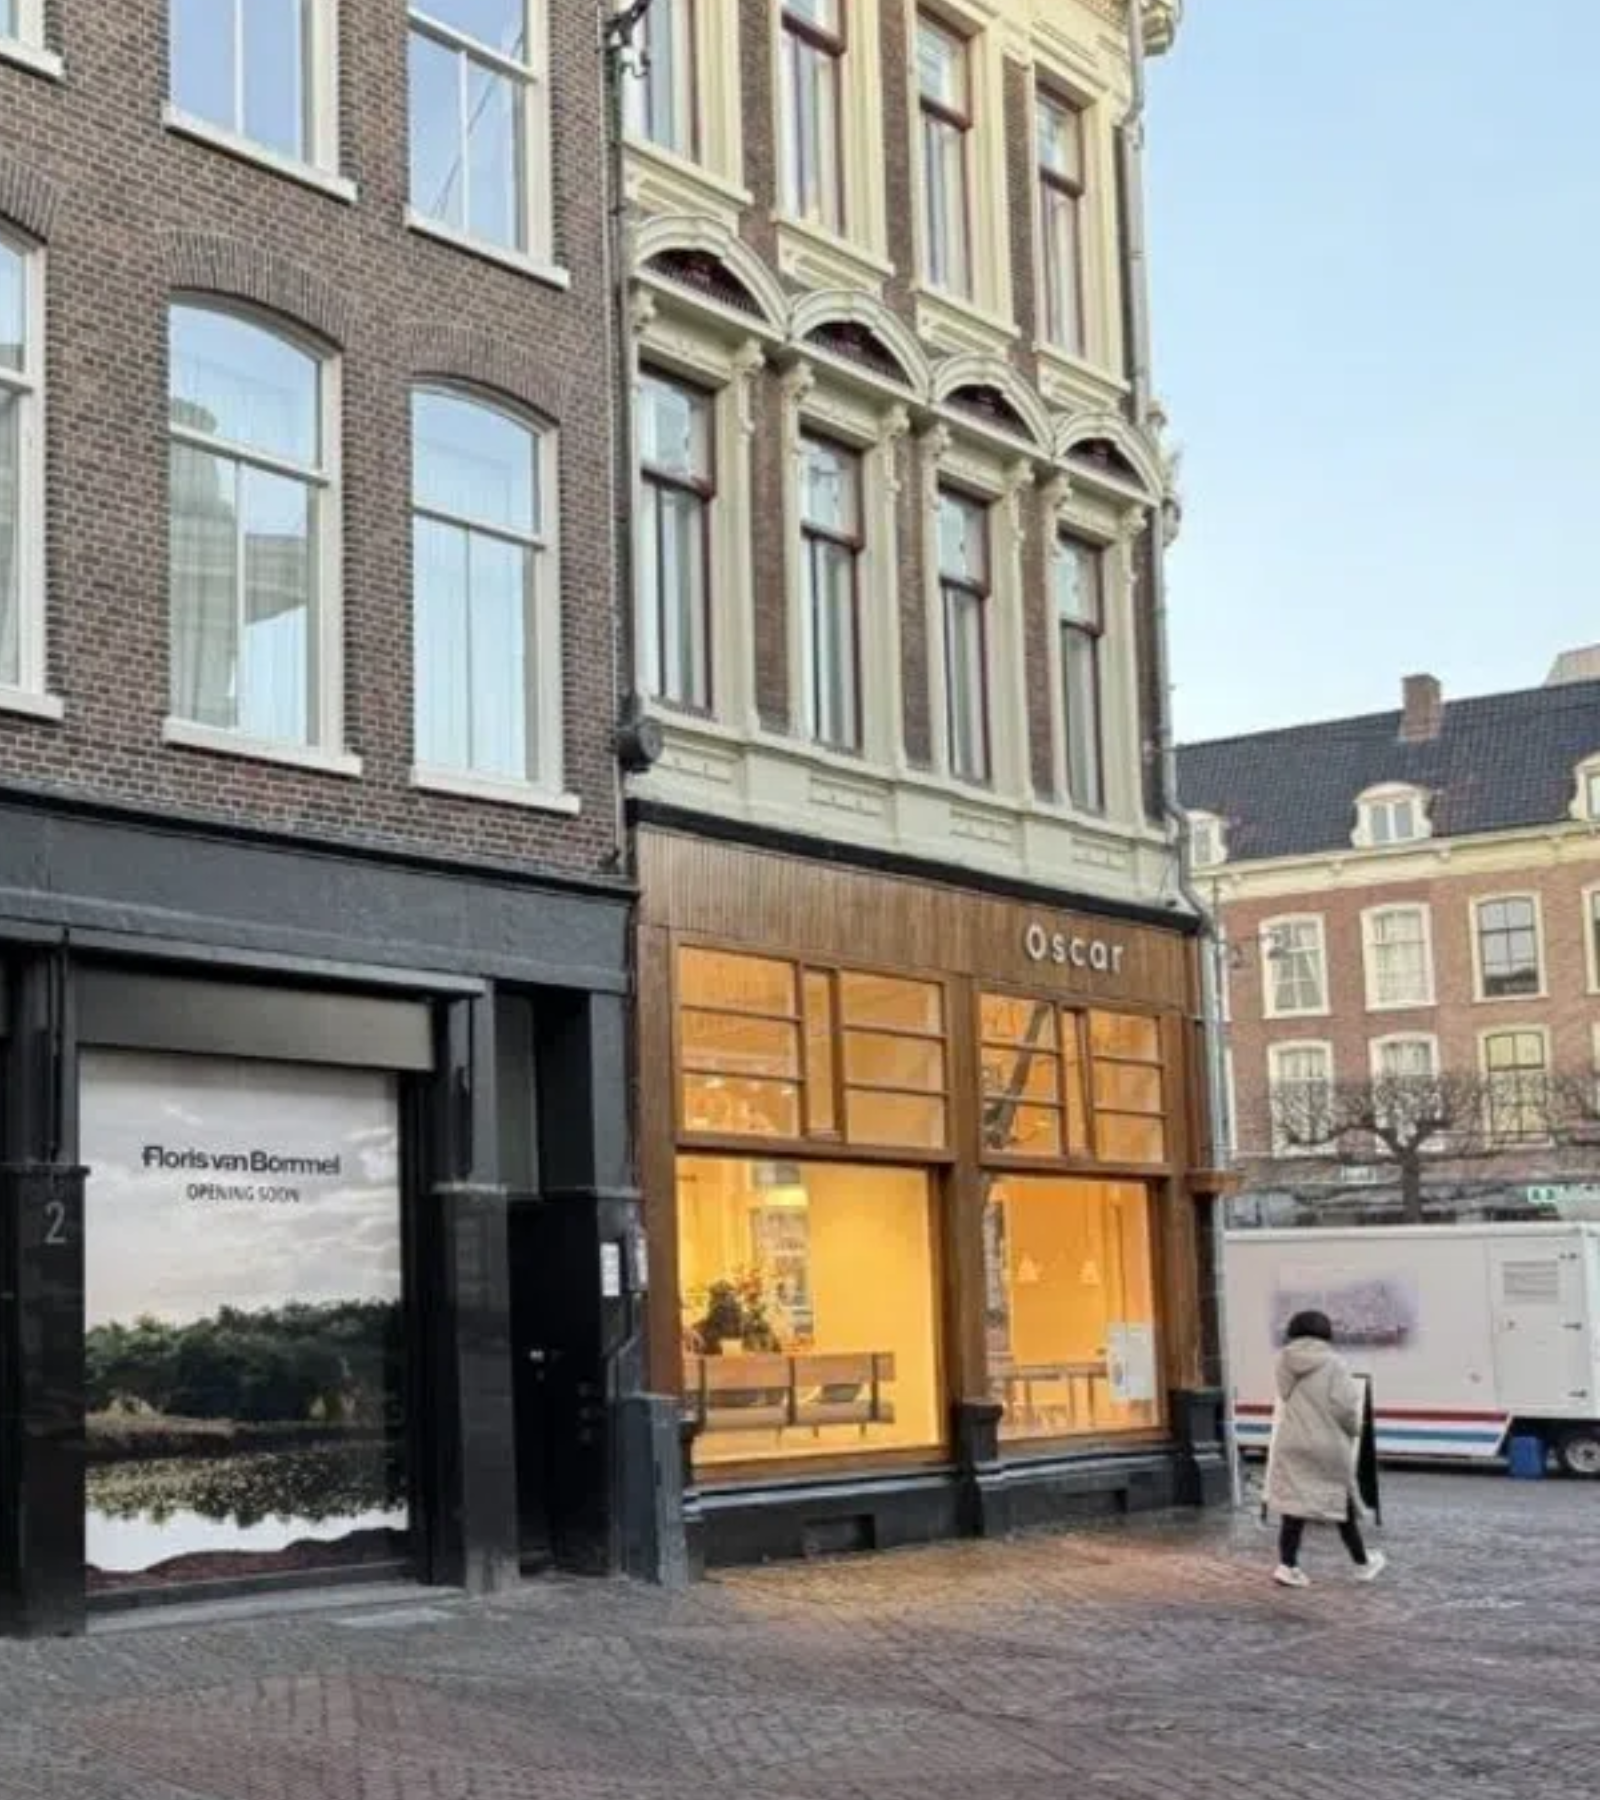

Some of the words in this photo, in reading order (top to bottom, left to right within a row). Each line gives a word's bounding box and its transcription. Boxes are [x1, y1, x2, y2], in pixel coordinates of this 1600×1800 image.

[1025, 921, 1124, 973] Oscar
[142, 1146, 208, 1169] Floris
[211, 1153, 248, 1172] van
[250, 1150, 340, 1175] Bommel
[186, 1183, 254, 1201] OPENING
[258, 1186, 300, 1203] SOON
[44, 1201, 67, 1244] 2
